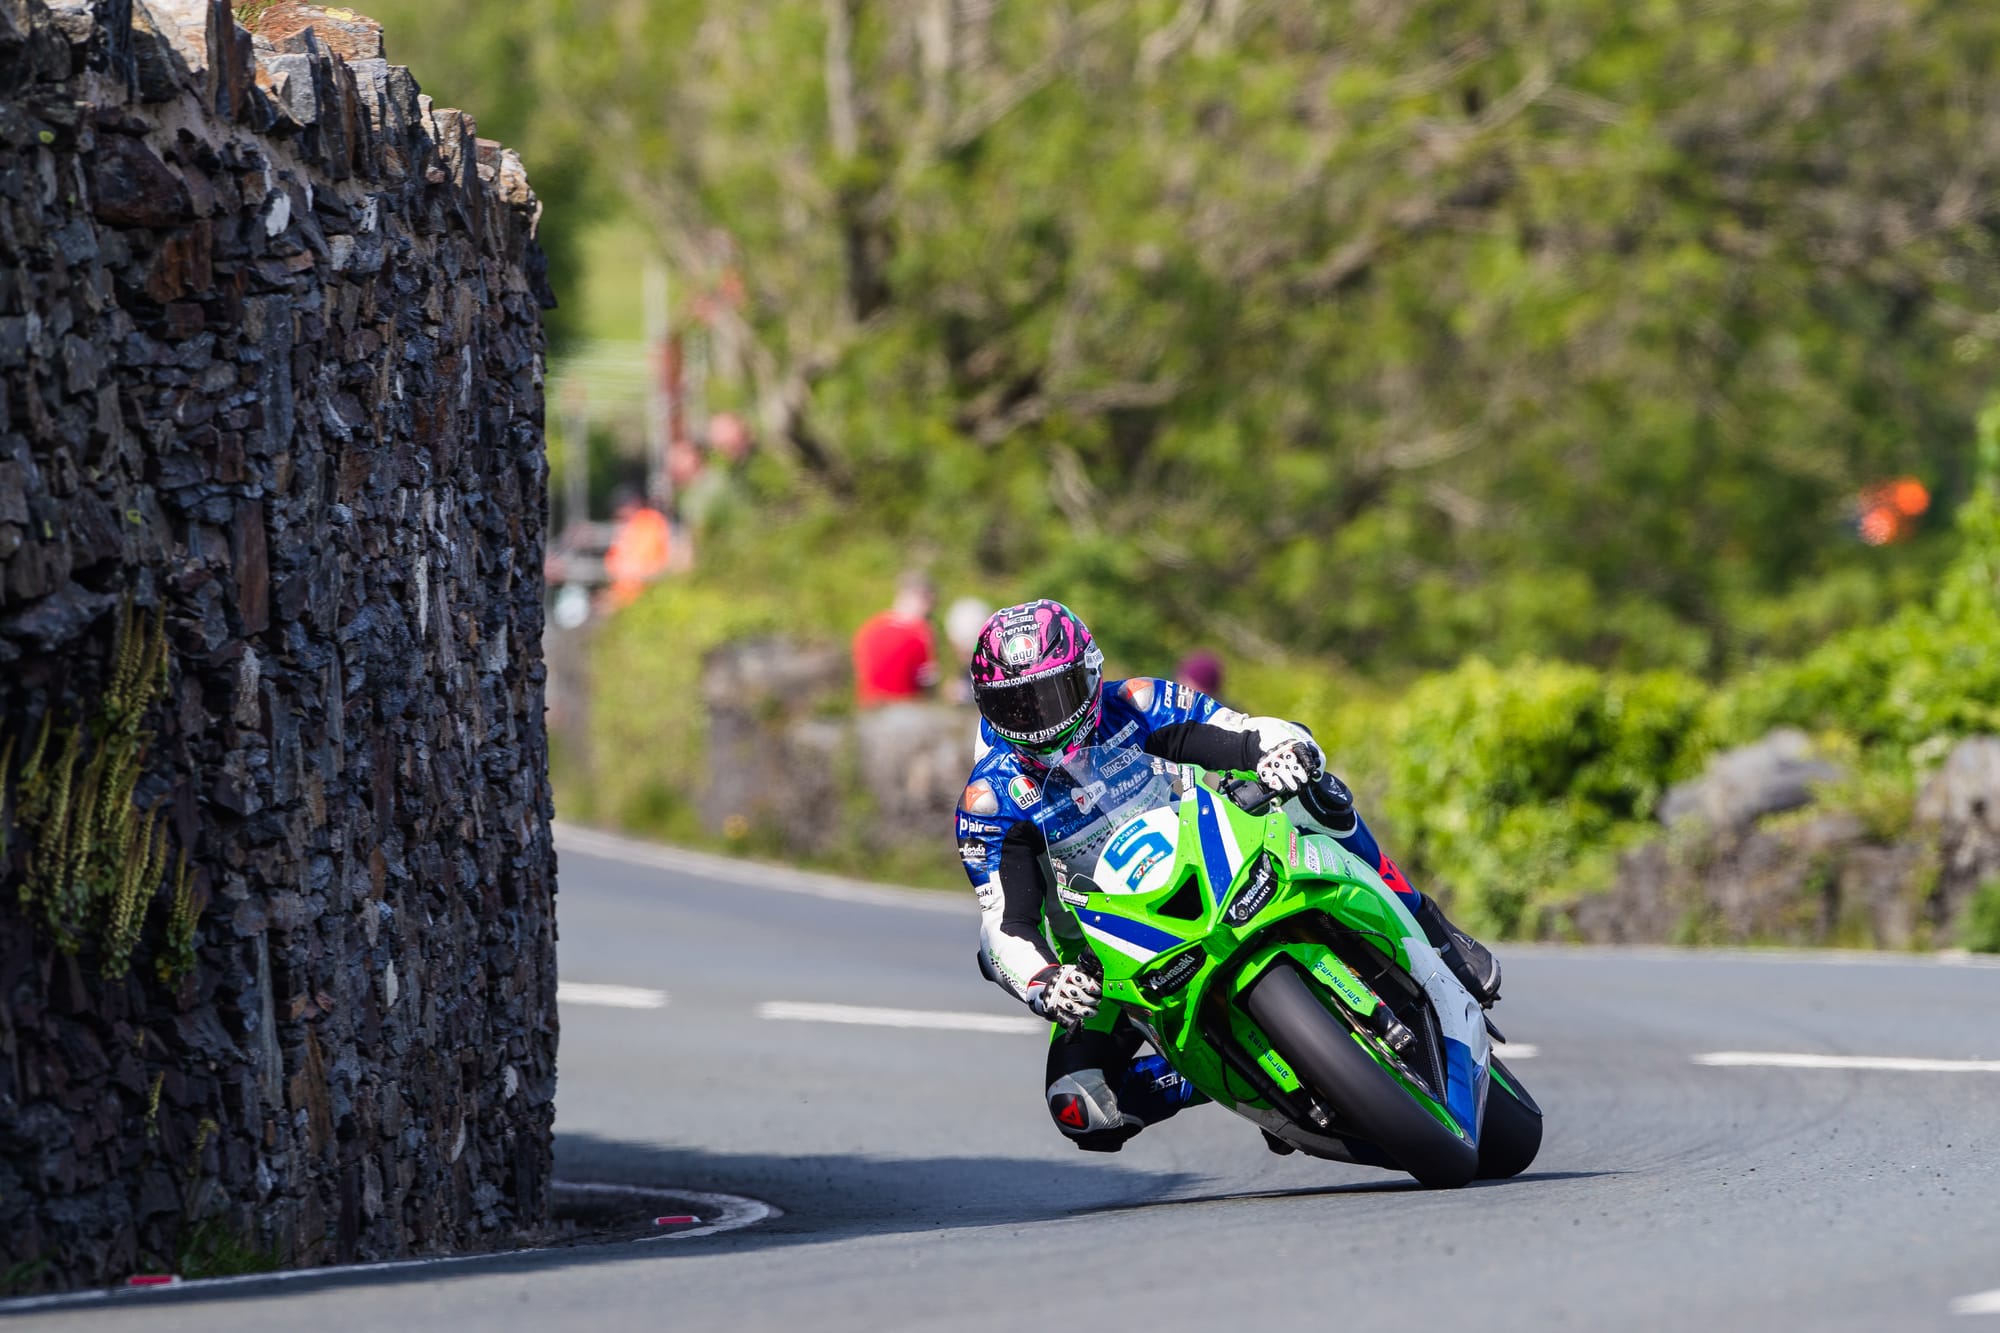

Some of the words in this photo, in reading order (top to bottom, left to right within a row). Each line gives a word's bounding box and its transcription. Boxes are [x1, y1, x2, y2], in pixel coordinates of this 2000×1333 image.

[995, 622, 1043, 638] brenmar
[1011, 648, 1034, 663] agv
[1011, 674, 1036, 686] COUNTY
[1036, 665, 1066, 680] WINDOWS
[1038, 699, 1092, 739] DISTINCTION
[1019, 787, 1040, 806] agv
[1110, 769, 1149, 798] bitubo
[1104, 817, 1174, 892] 5
[977, 887, 993, 898] saki
[1249, 885, 1271, 913] NSURANCE
[1149, 953, 1196, 991] Kawasaki
[1314, 960, 1362, 1006] METZELER
